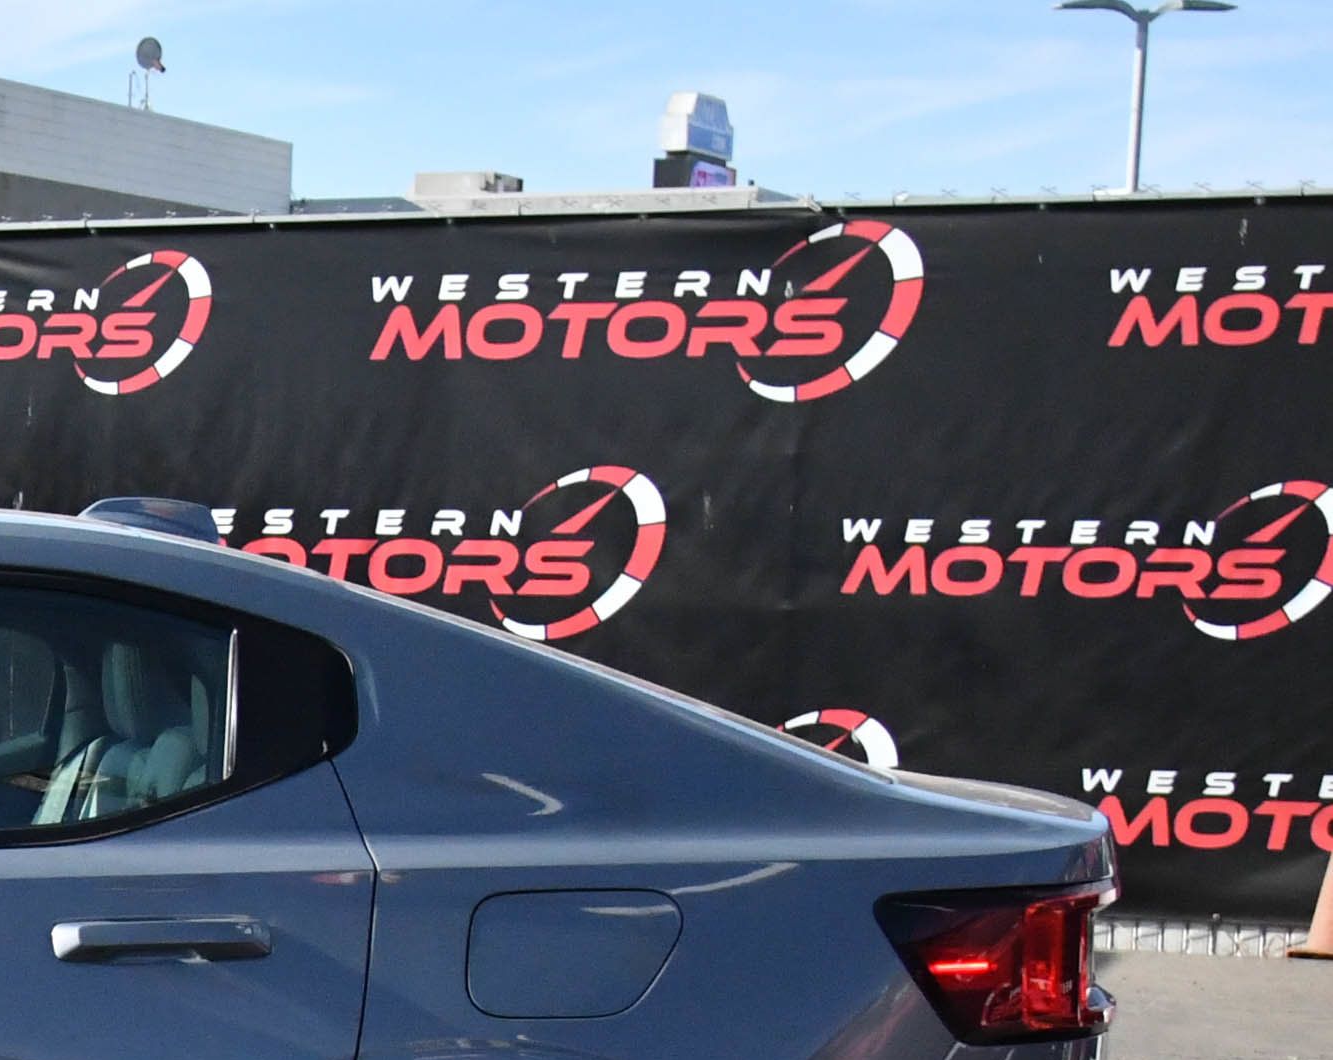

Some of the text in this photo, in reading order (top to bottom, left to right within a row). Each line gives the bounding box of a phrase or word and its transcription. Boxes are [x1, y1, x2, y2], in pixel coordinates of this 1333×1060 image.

[371, 269, 772, 303] WESTERN
[368, 297, 849, 361] MOTORS
[210, 509, 523, 537] ESTERN
[842, 517, 1216, 546] WESTERN
[218, 538, 595, 597] TORS
[840, 543, 1288, 600] MOTORS
